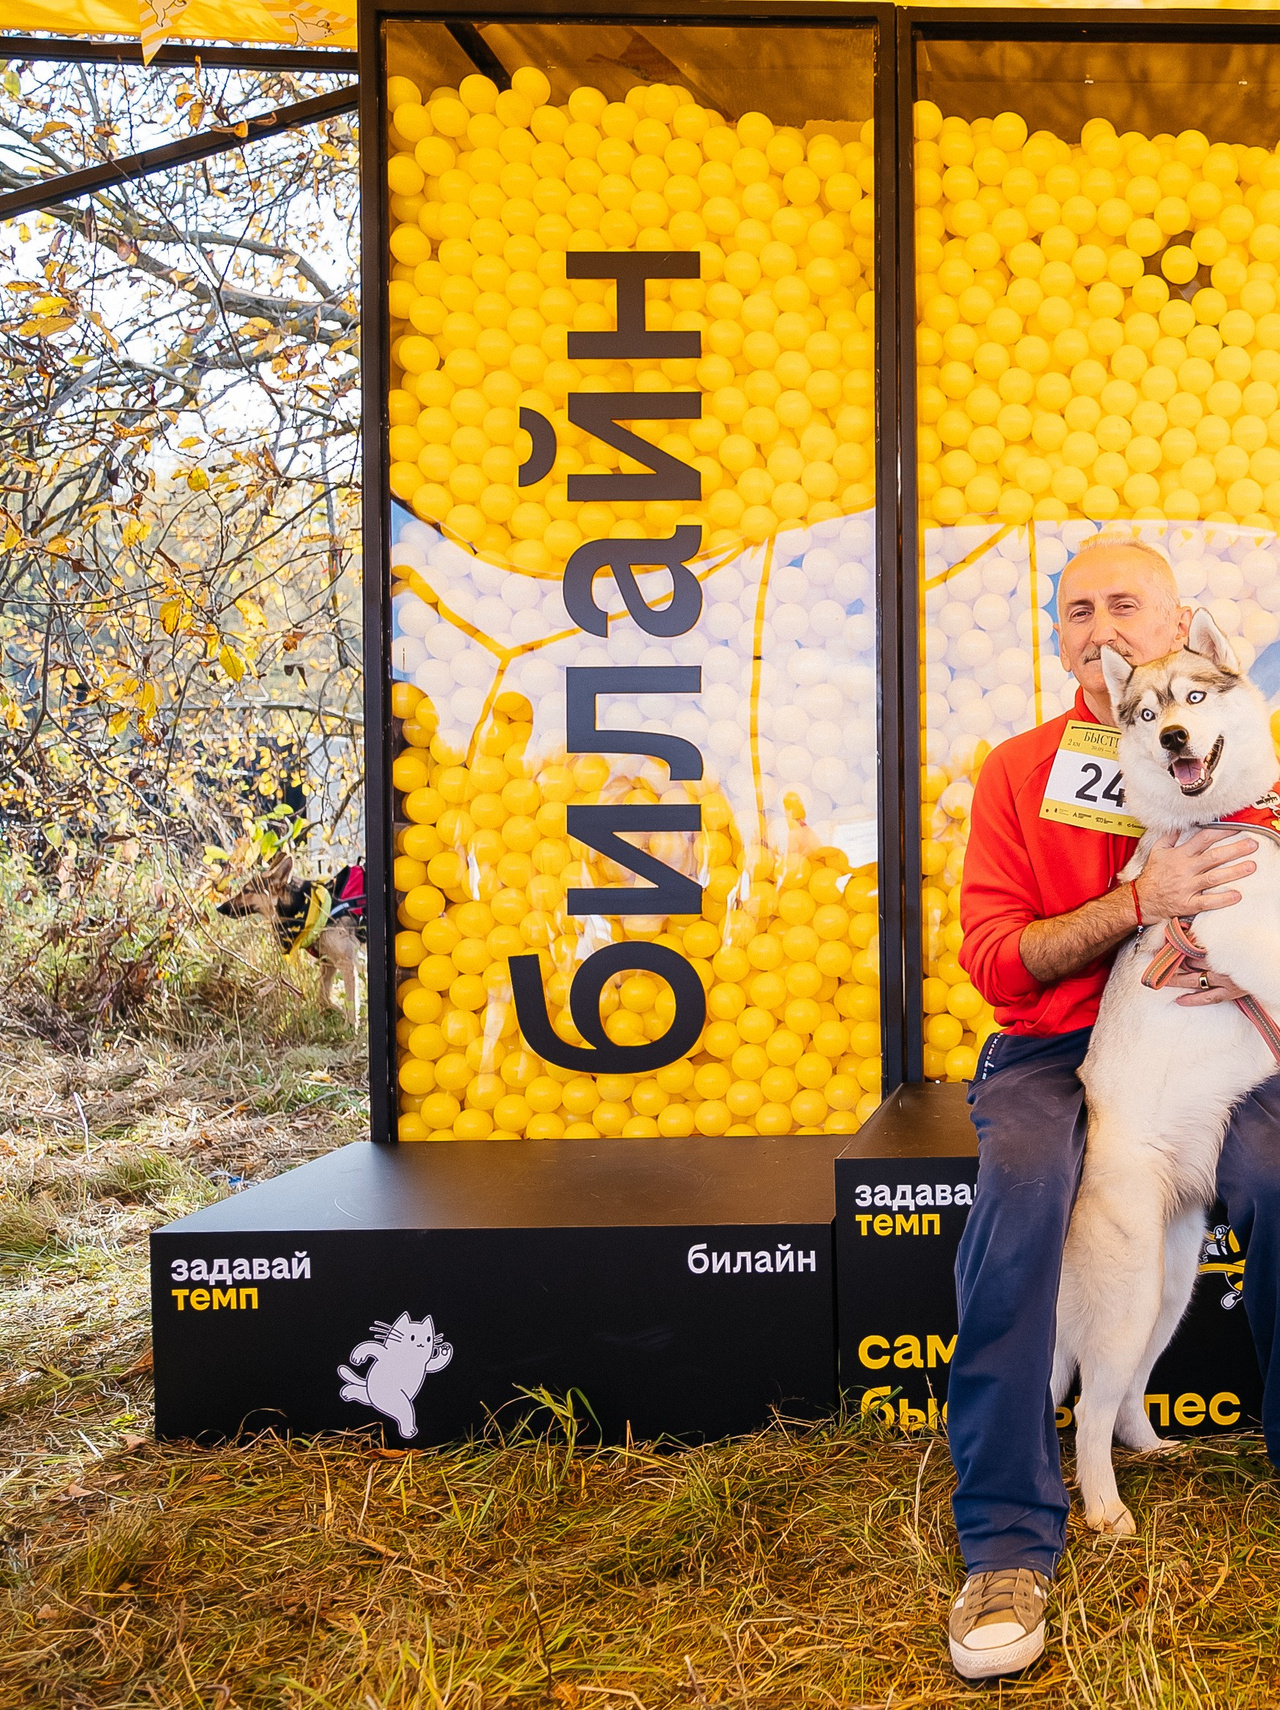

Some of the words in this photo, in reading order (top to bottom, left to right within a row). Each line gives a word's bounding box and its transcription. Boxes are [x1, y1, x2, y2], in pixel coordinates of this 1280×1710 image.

[508, 250, 707, 1075] билайн
[854, 1183, 977, 1212] задава
[854, 1213, 941, 1237] темп
[170, 1250, 312, 1286] задавай
[687, 1242, 817, 1275] билайн
[171, 1287, 259, 1312] темп
[1143, 1391, 1241, 1427] пес
